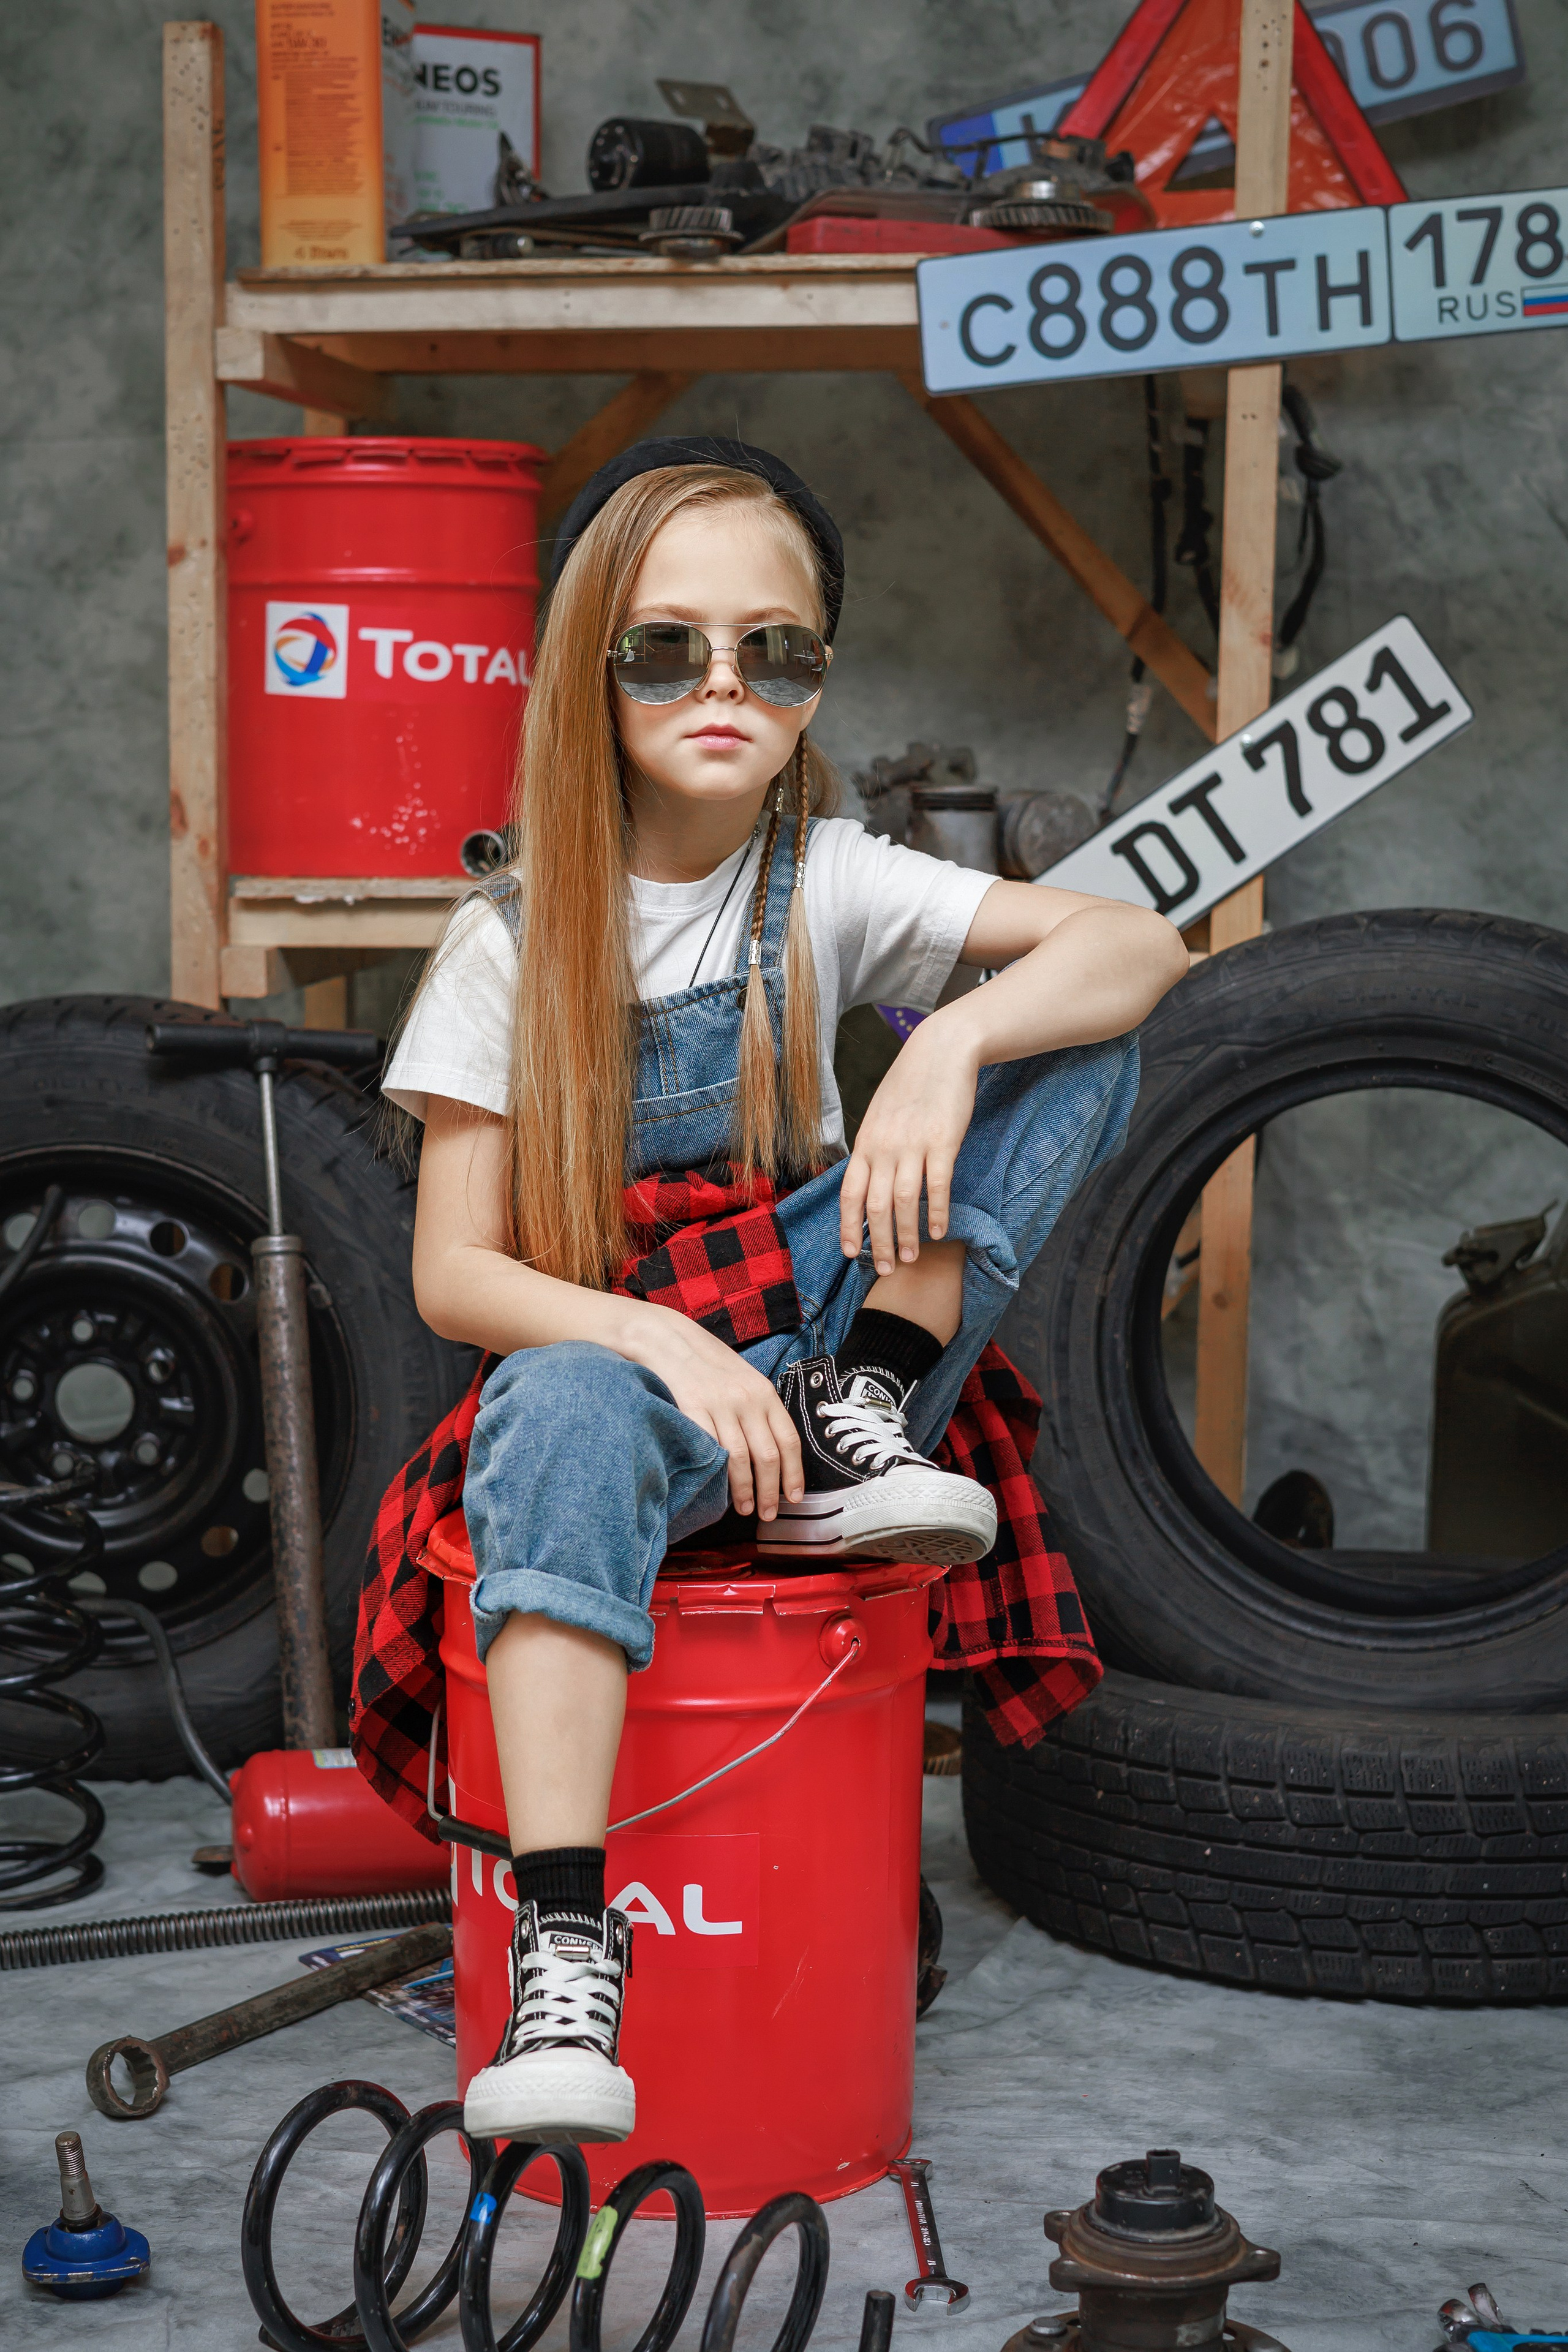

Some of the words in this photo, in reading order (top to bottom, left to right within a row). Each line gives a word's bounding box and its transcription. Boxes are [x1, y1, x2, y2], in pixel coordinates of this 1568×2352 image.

[960, 246, 1374, 366] C888TH
[1403, 202, 1564, 288] 178
[1437, 291, 1517, 324] RUS
[1110, 771, 1247, 916] DT
[1241, 646, 1452, 818] 781
